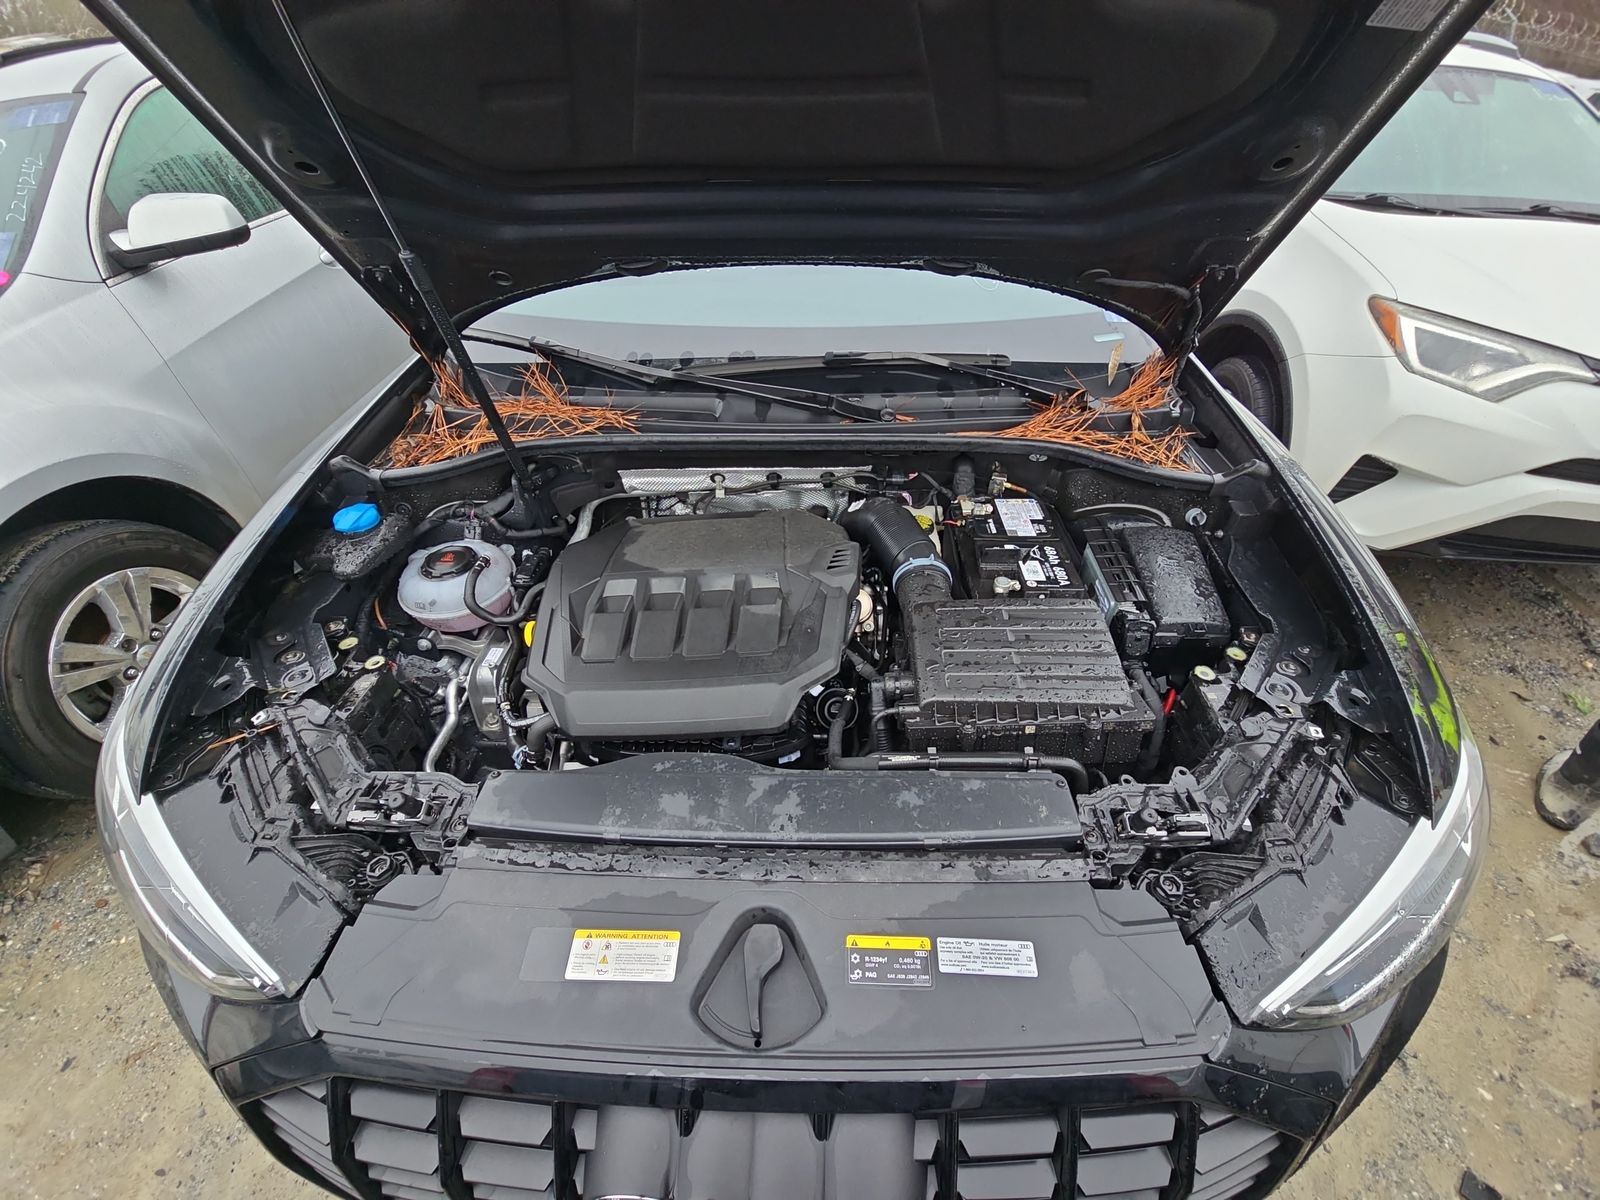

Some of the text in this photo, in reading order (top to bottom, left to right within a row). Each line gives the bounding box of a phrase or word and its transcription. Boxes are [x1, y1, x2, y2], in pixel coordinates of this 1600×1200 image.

[5, 152, 43, 222] 224242
[1044, 546, 1060, 564] 68Ah
[1052, 566, 1070, 586] 680A
